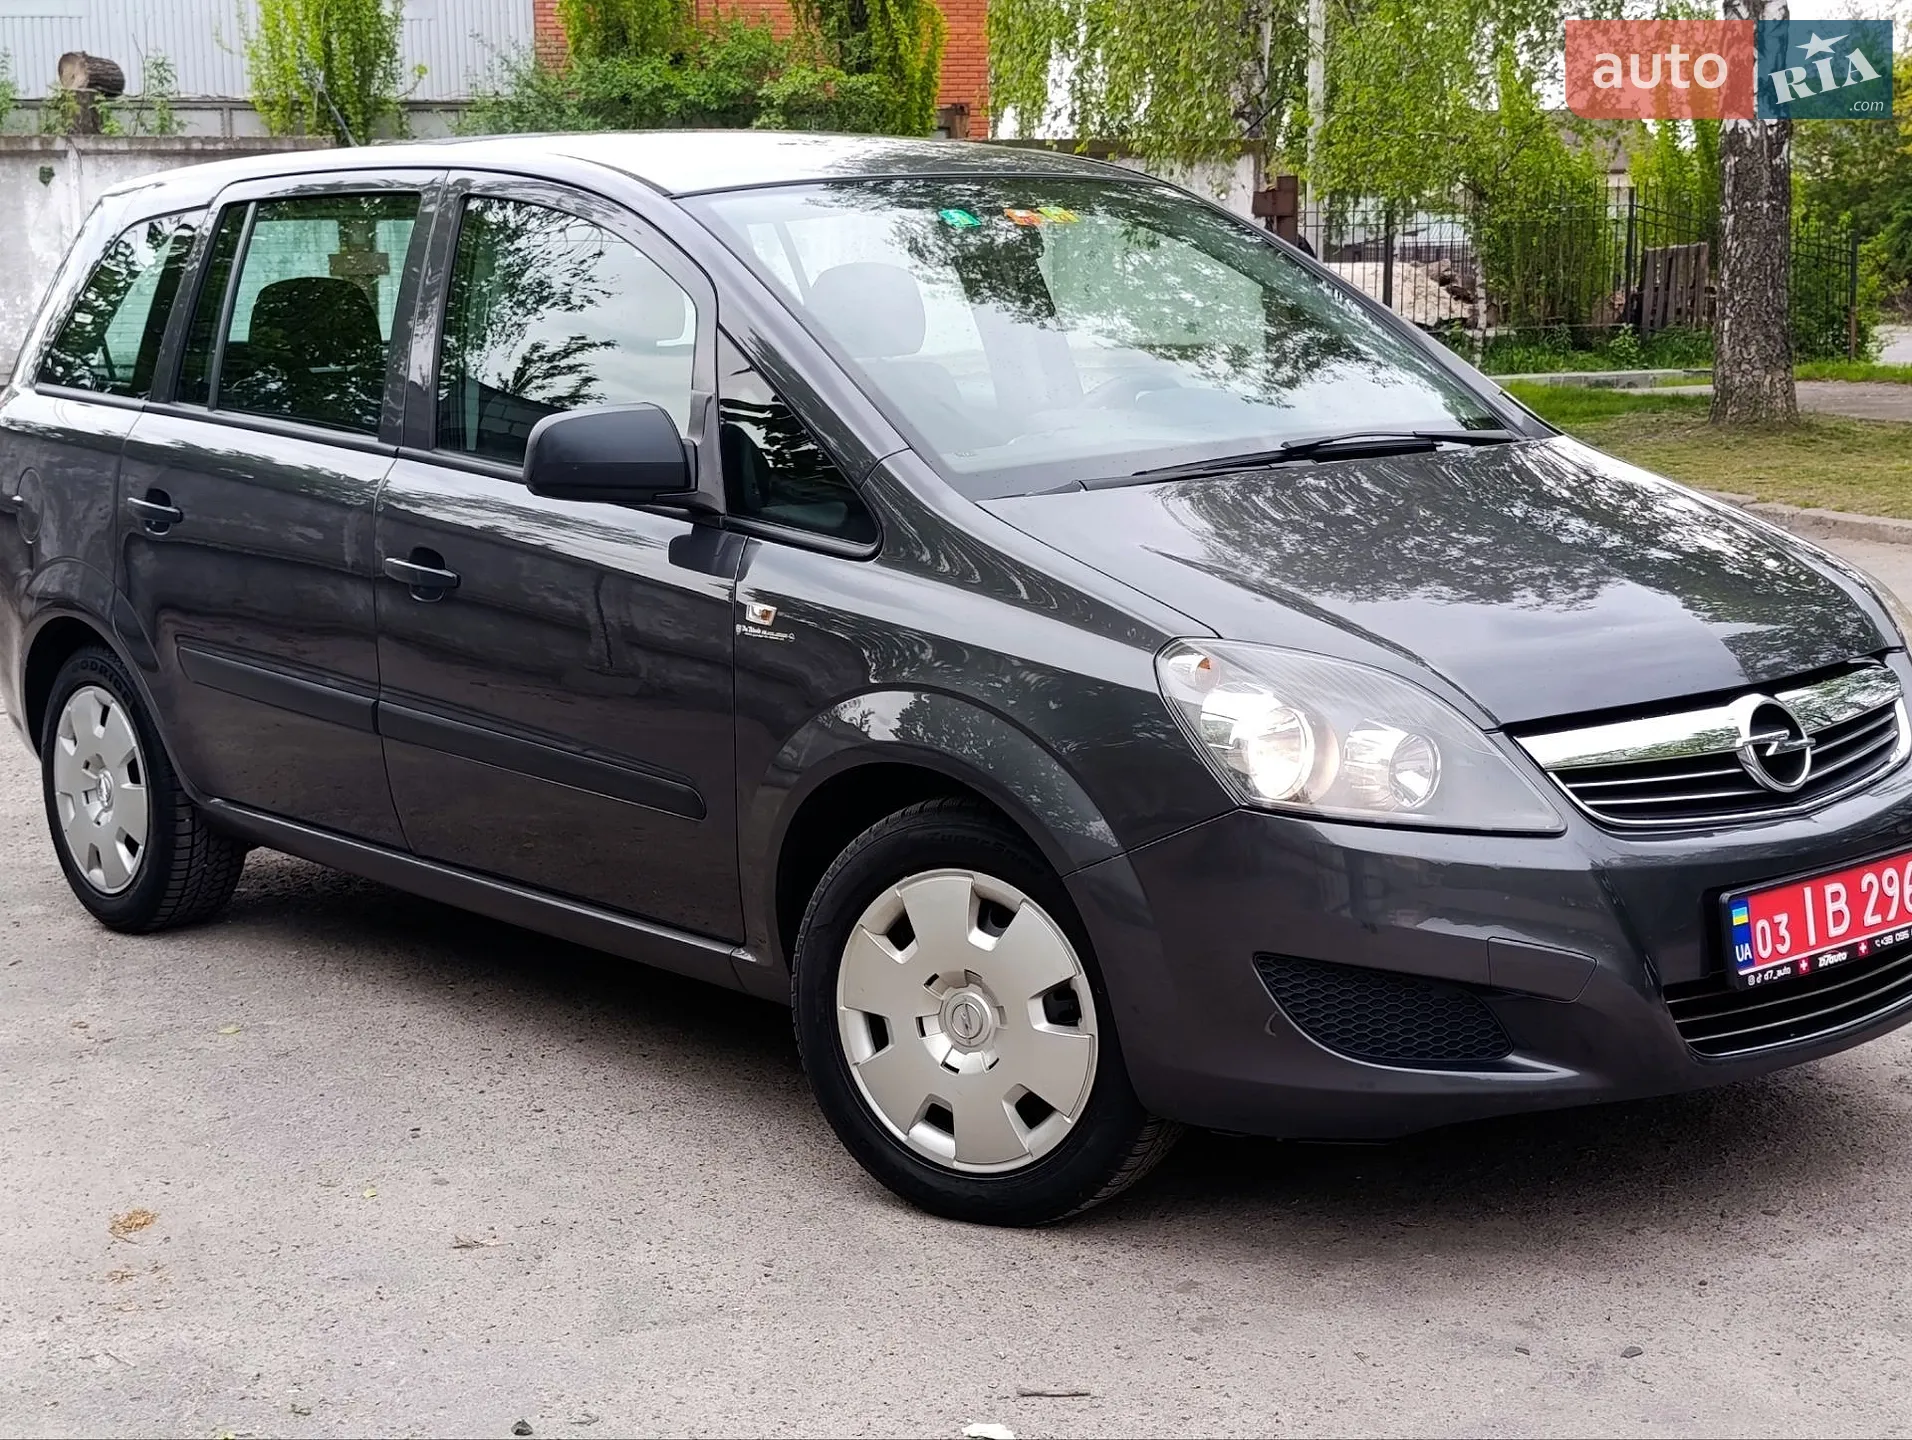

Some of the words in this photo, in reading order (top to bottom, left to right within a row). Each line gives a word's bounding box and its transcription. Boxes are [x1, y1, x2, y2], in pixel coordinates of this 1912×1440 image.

[1755, 912, 1791, 959] 03
[1803, 882, 1850, 947] IB
[1736, 943, 1752, 962] UA
